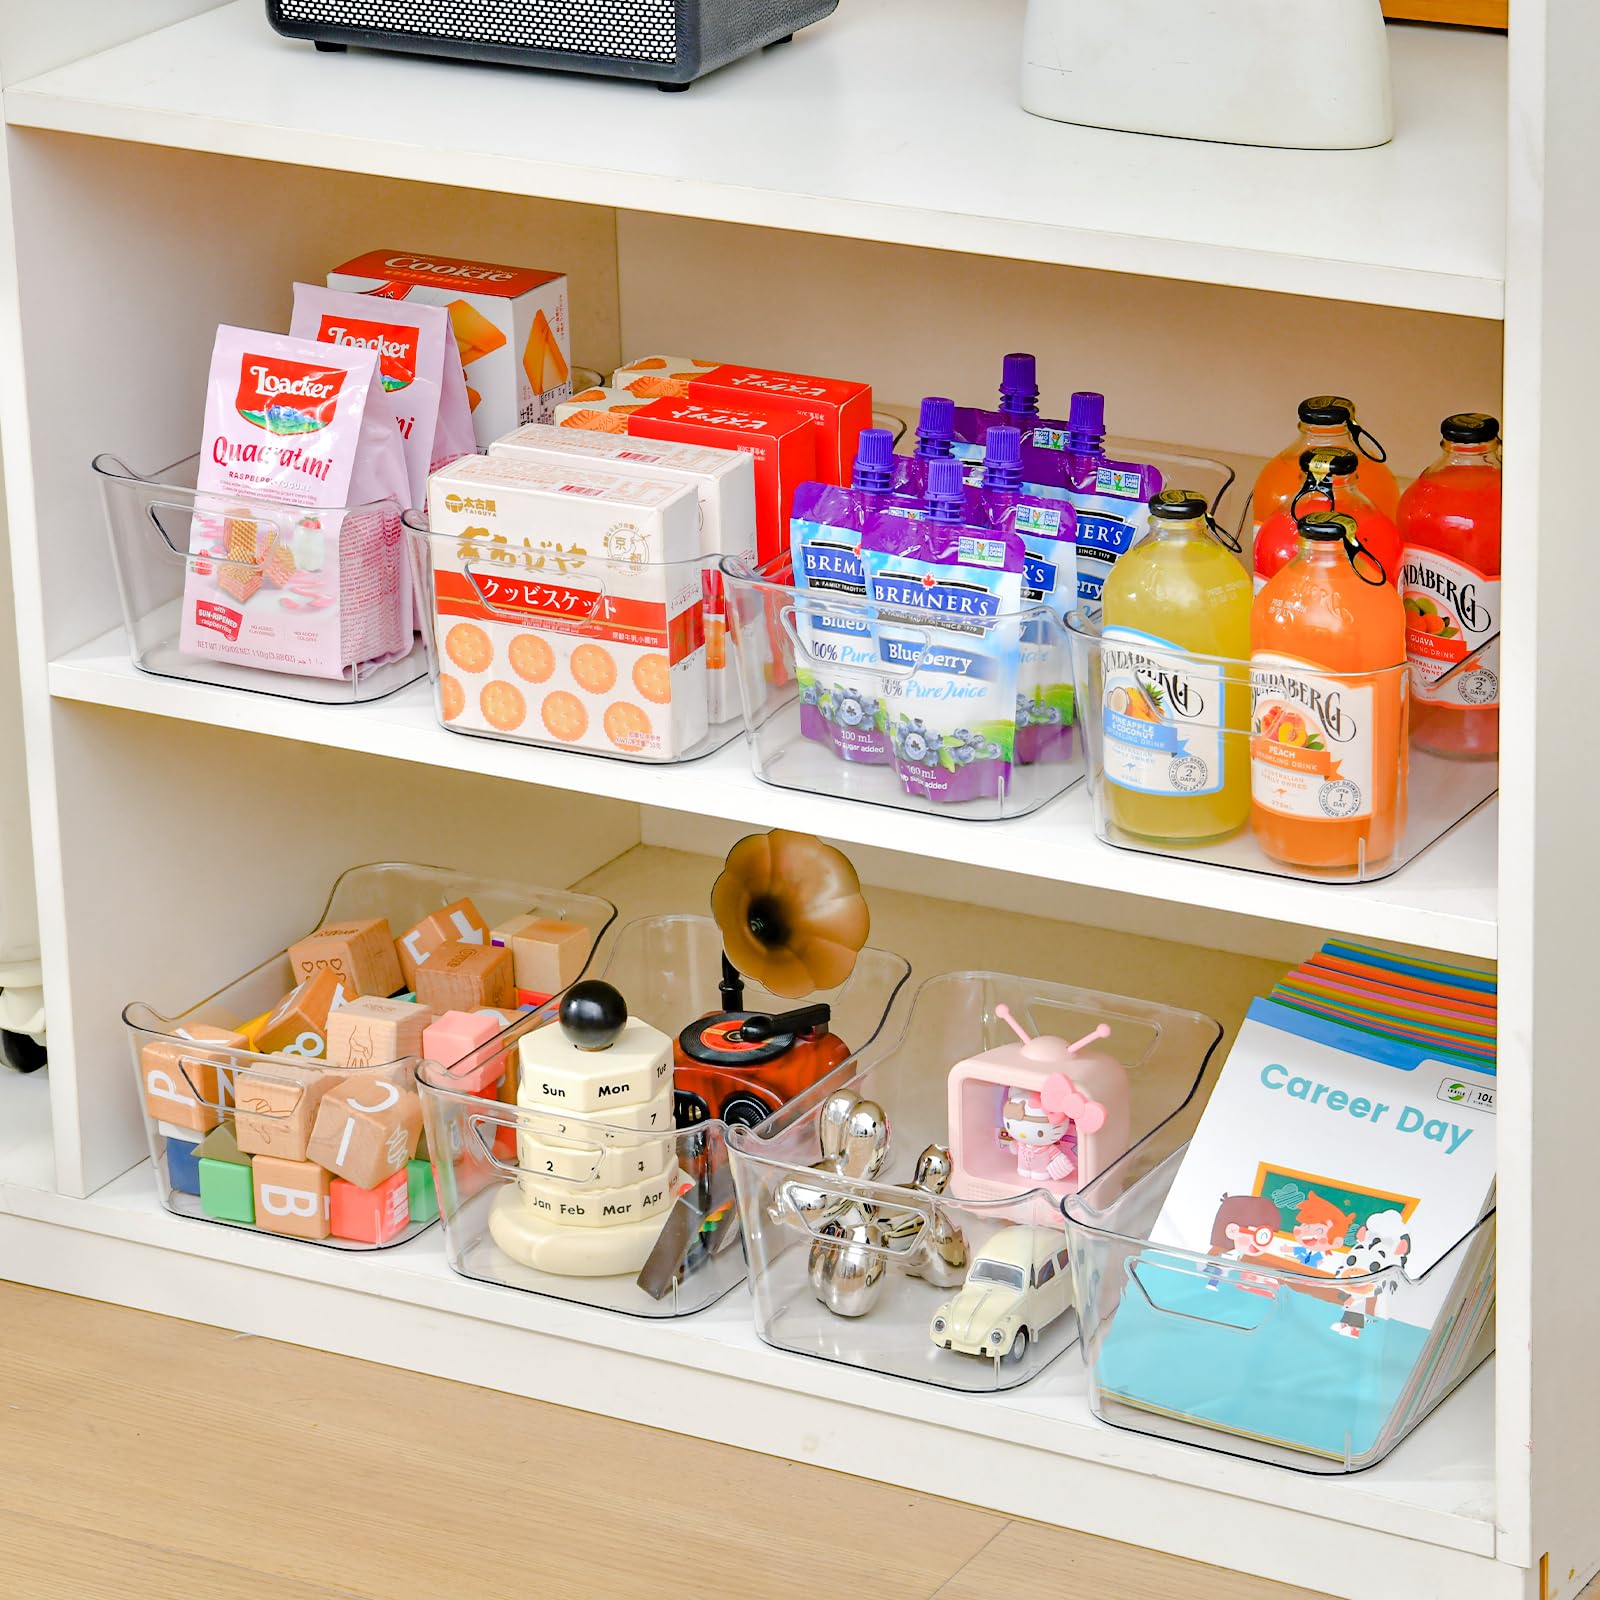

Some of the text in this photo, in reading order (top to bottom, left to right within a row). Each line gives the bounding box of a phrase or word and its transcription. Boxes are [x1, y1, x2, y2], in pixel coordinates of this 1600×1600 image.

[385, 257, 513, 282] Cookie
[328, 327, 410, 359] Loacker
[249, 366, 334, 399] Loacker
[212, 436, 333, 482] Quaatini
[1078, 548, 1097, 556] SINCE
[875, 584, 989, 617] BREMNER'S
[1410, 634, 1434, 647] GUAVA
[841, 645, 878, 664] Pure
[888, 643, 973, 676] Blueberry
[1431, 650, 1455, 659] DRINK
[905, 680, 942, 699] Pure
[944, 680, 988, 699] Juice
[1476, 681, 1483, 690] 2
[1112, 714, 1154, 732] PINEAPPLE
[841, 730, 873, 744] 100 mL
[1117, 725, 1155, 739] COCONUT
[834, 738, 884, 753] No sugar added
[1269, 745, 1296, 759] PEACH
[1186, 769, 1193, 777] 2
[1292, 761, 1317, 771] DRINK
[921, 768, 937, 780] mL
[925, 781, 947, 791] added
[1339, 793, 1344, 802] 1
[542, 1063, 667, 1098] Sun Mon Tue
[1260, 1063, 1474, 1155] Career Day
[546, 1160, 553, 1172] 2
[261, 1184, 318, 1217] B
[533, 1196, 552, 1211] Jan
[560, 1203, 585, 1215] Feb
[602, 1204, 632, 1216] Mar
[642, 1191, 663, 1207] Apr
